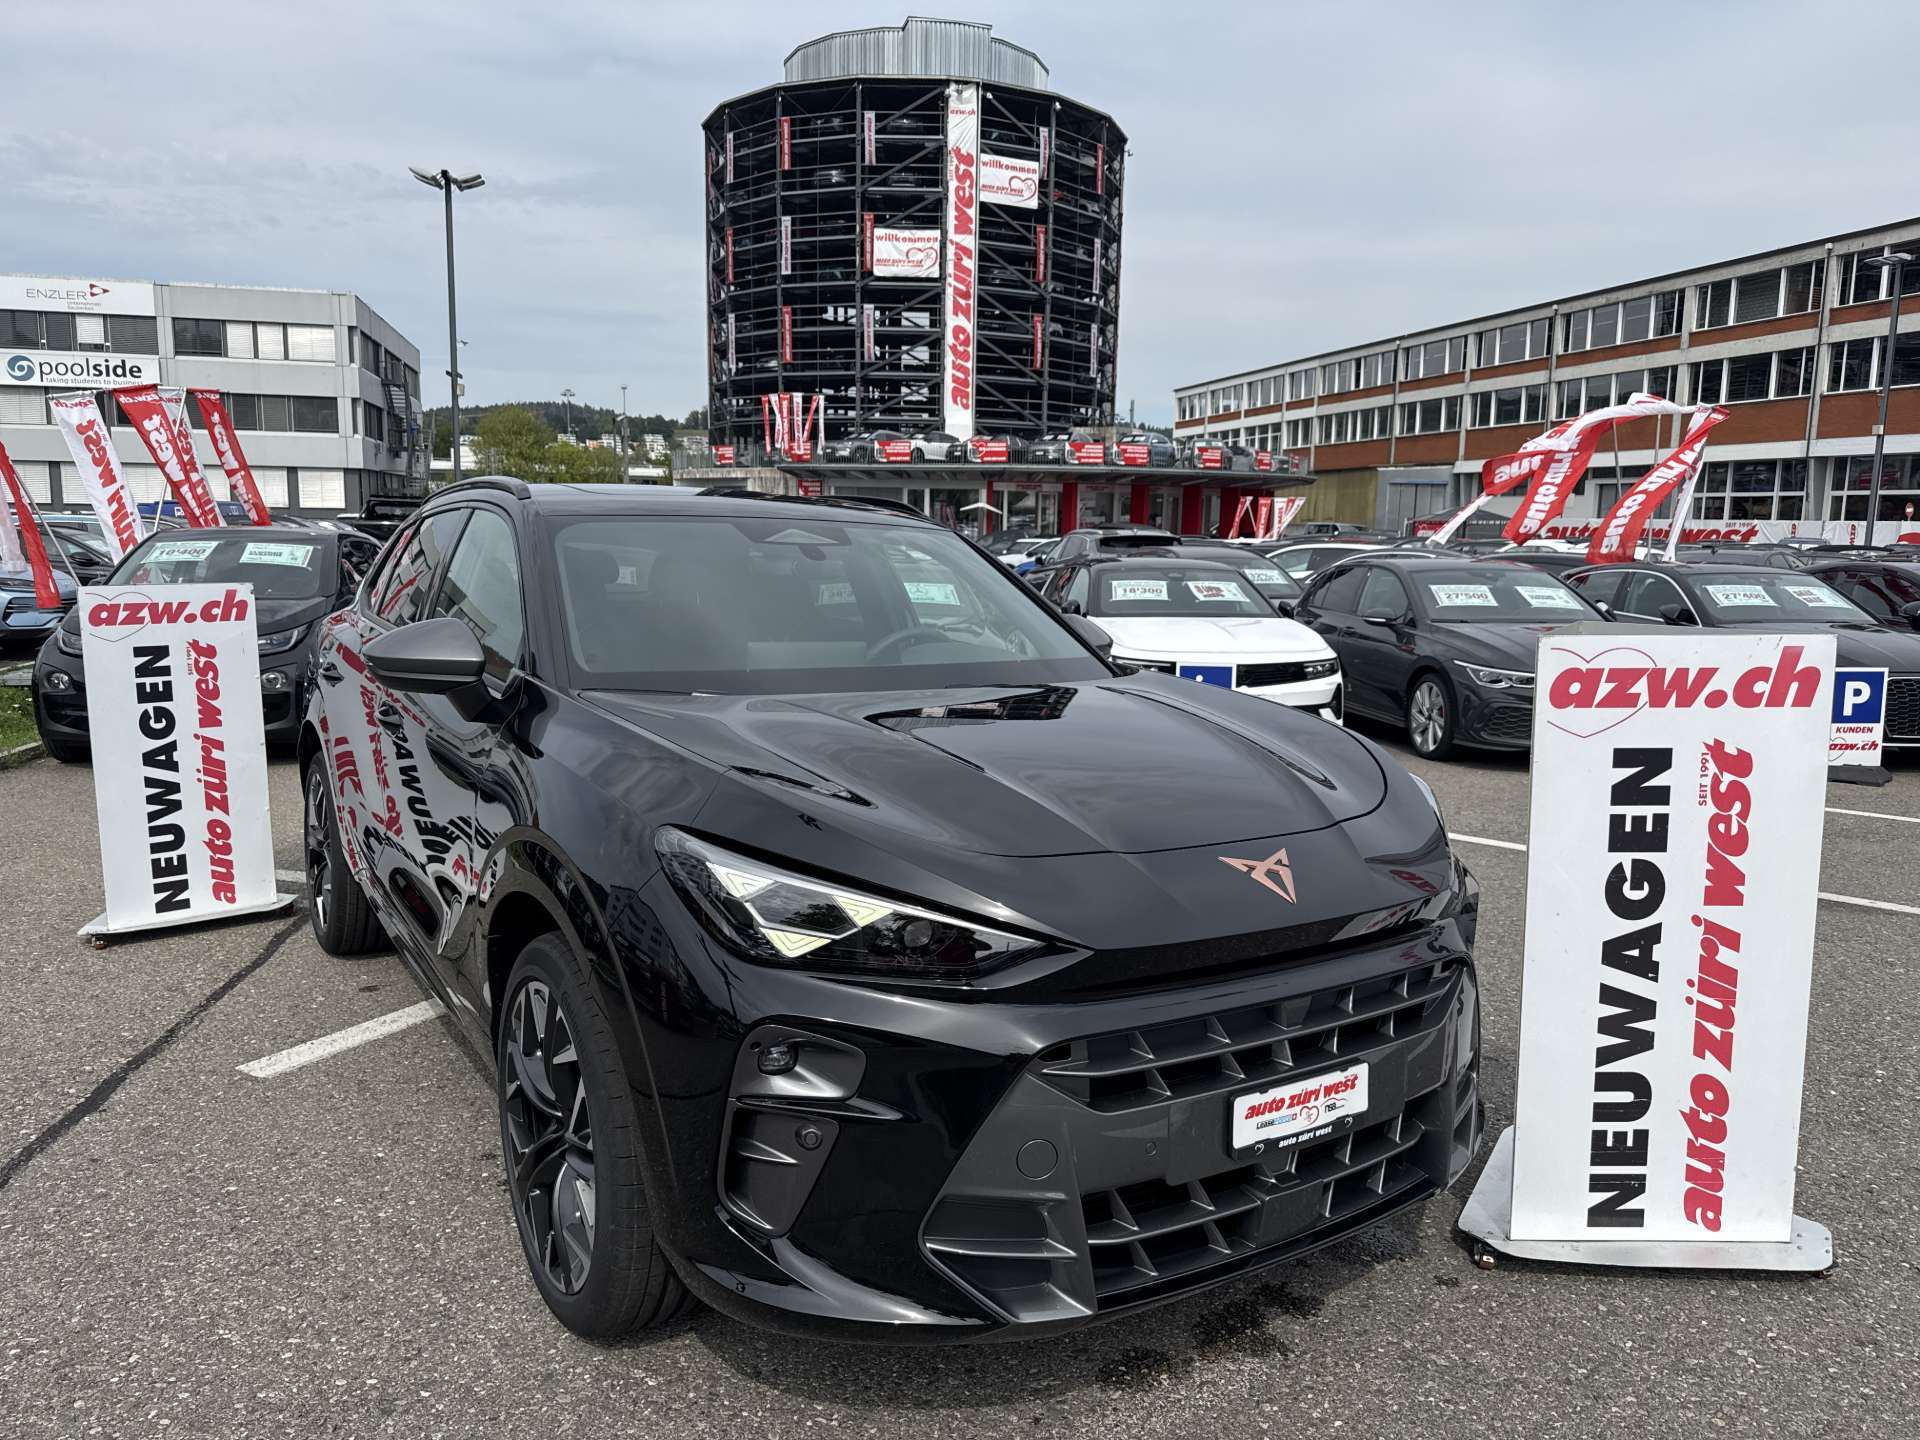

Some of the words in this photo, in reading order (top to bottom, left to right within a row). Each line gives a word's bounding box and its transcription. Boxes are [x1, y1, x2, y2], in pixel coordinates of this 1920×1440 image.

[953, 145, 975, 236] west
[981, 159, 1037, 175] willkommen
[875, 232, 938, 243] willkommen
[26, 288, 87, 301] ENZLER
[948, 238, 974, 325] züri
[39, 357, 143, 383] poolside
[45, 377, 69, 385] taking
[948, 324, 972, 411] auto
[88, 588, 249, 628] azw.ch
[186, 638, 223, 729] west
[1549, 645, 1822, 710] azw.ch
[1842, 681, 1871, 716] P
[1829, 740, 1879, 751] azw.ch
[1835, 726, 1874, 734] KUNDEN
[132, 644, 192, 915] NEUWAGEN
[193, 732, 232, 818] züri
[1700, 752, 1710, 778] 1991
[1698, 783, 1708, 807] SEIT
[1702, 737, 1754, 907] west
[202, 817, 238, 906] auto
[1586, 747, 1674, 1229] NEUWAGEN
[1684, 914, 1743, 1074] züri
[1244, 1095, 1286, 1120] auto
[1286, 1083, 1323, 1110] züri
[1323, 1073, 1359, 1098] west
[1278, 1136, 1297, 1149] auto
[1315, 1125, 1333, 1137] west
[1677, 1072, 1731, 1234] auto
